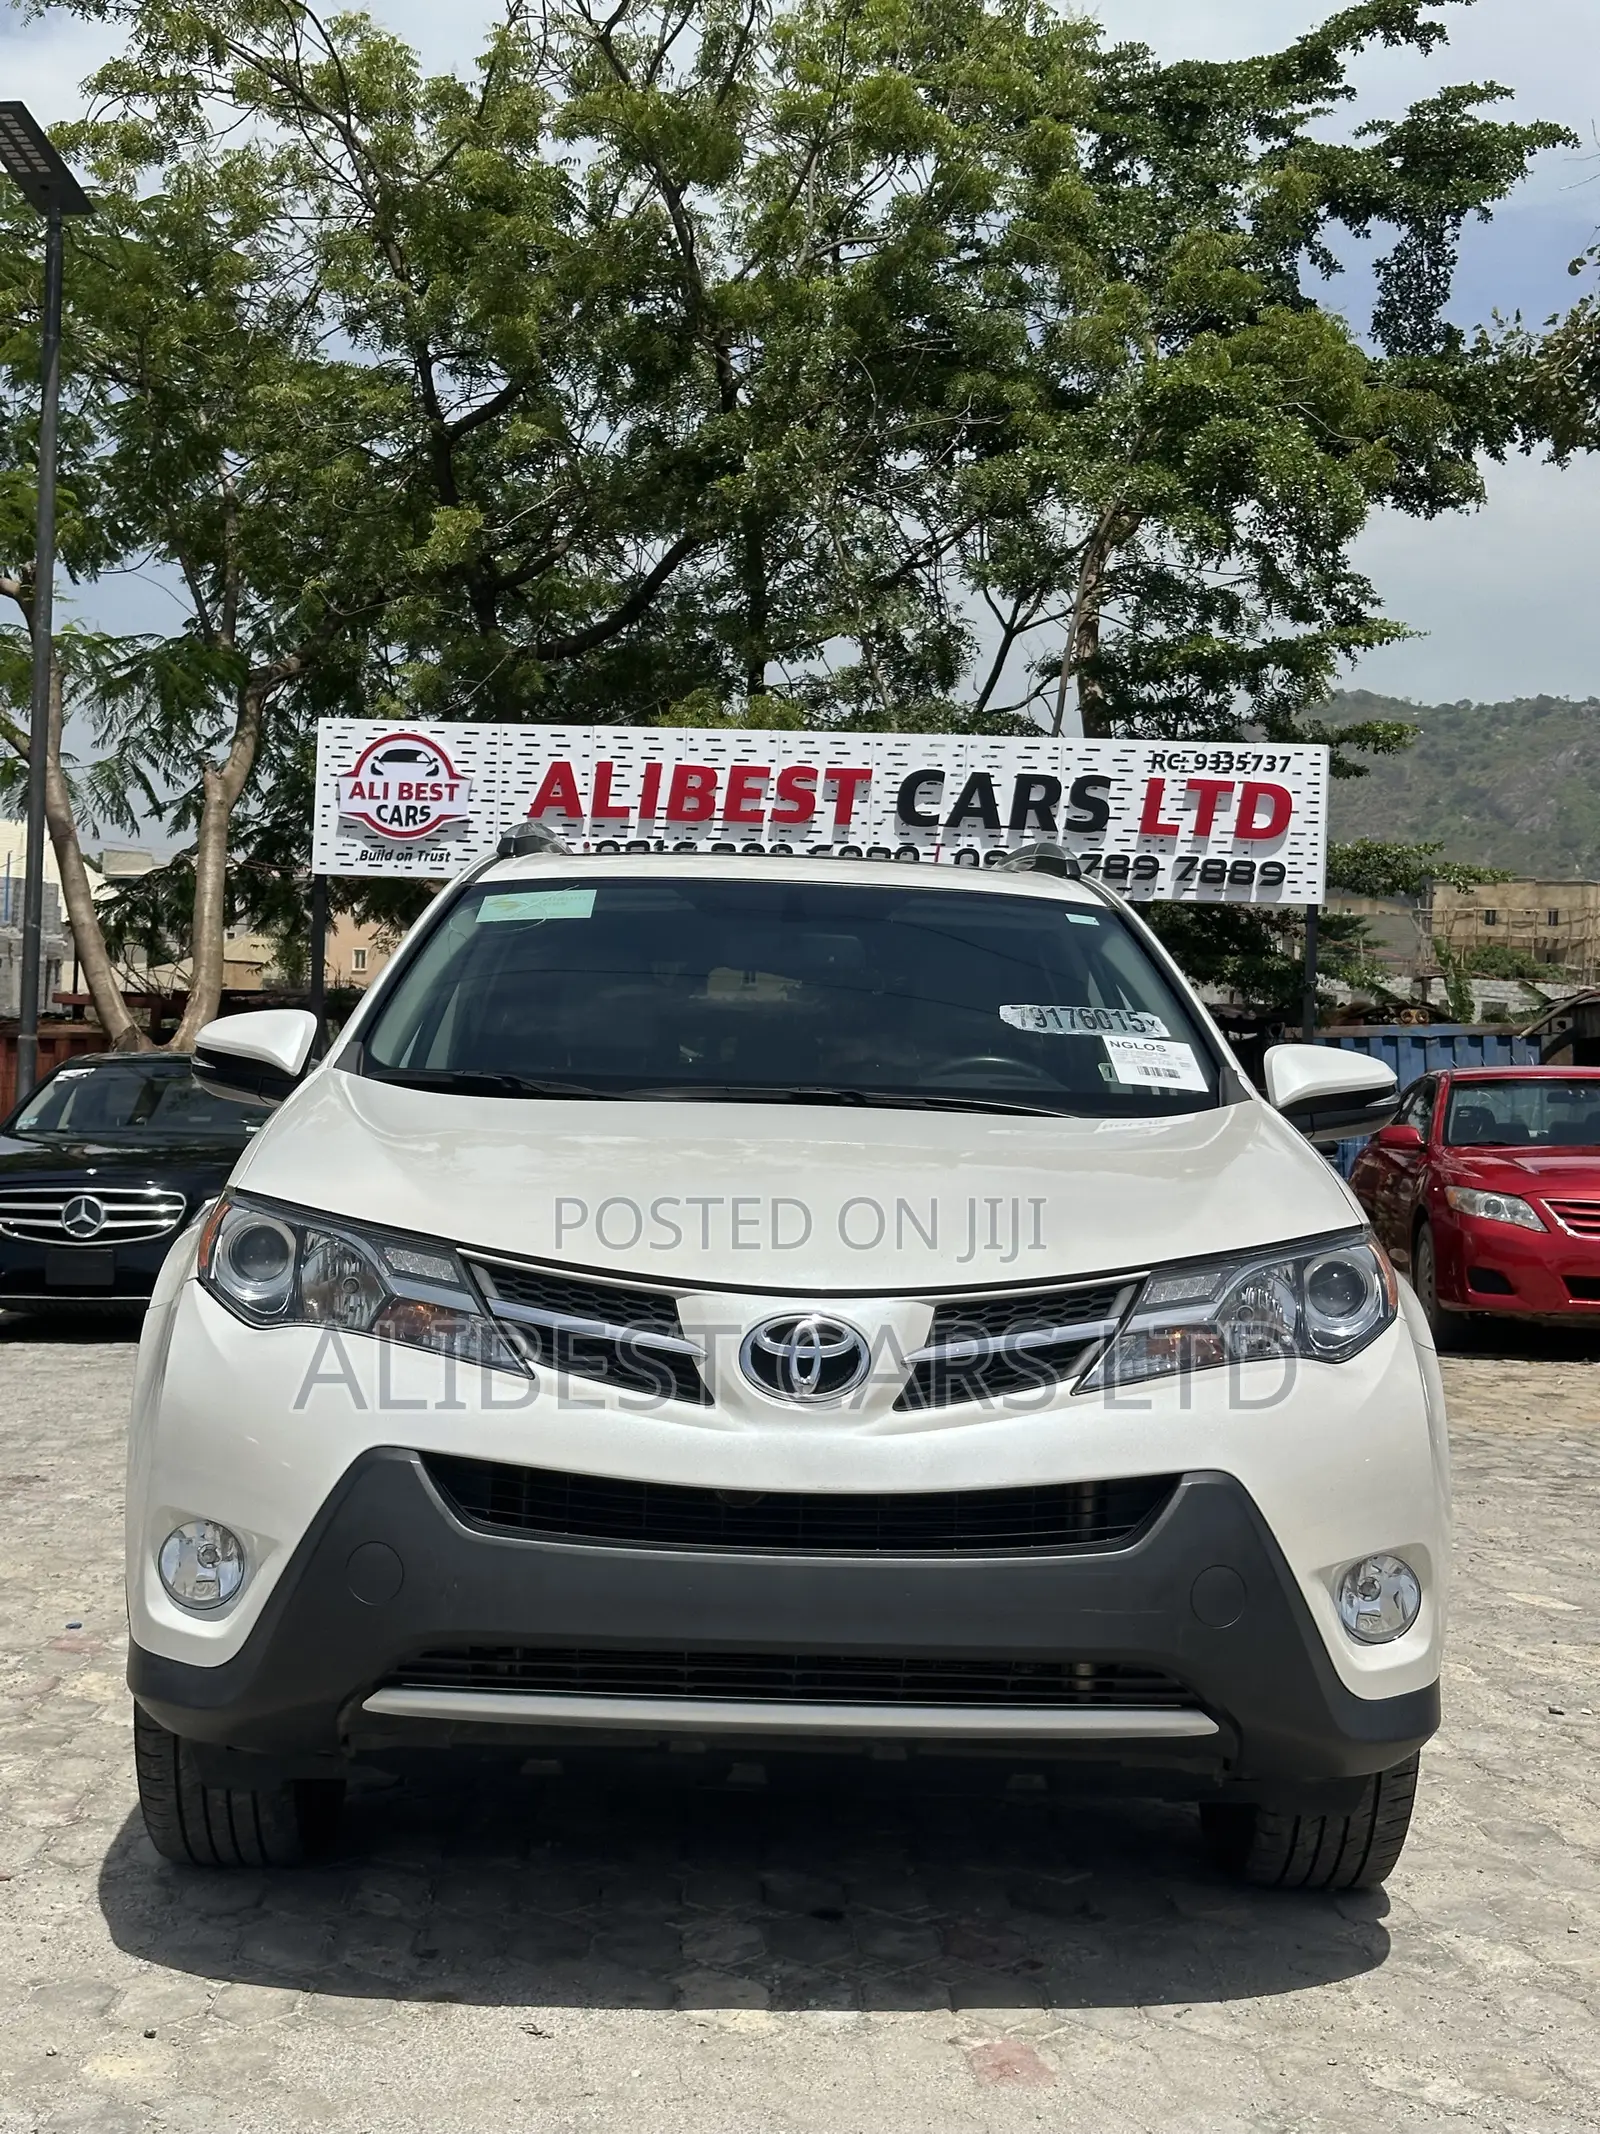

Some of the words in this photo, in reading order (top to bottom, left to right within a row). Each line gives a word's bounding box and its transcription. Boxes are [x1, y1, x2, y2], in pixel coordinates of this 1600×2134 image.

[1193, 752, 1292, 773] 9335737
[348, 781, 389, 800] ALI
[398, 782, 460, 802] BEST
[528, 761, 873, 826] ALIBEST
[896, 769, 1112, 834] CARS
[1139, 777, 1293, 840] LTD
[375, 804, 431, 827] CARS
[359, 849, 393, 862] Build
[396, 852, 412, 862] on
[417, 850, 451, 863] Trust
[1078, 853, 1160, 881] 789
[1174, 855, 1287, 887] 7889
[1108, 1040, 1167, 1053] NGLOS
